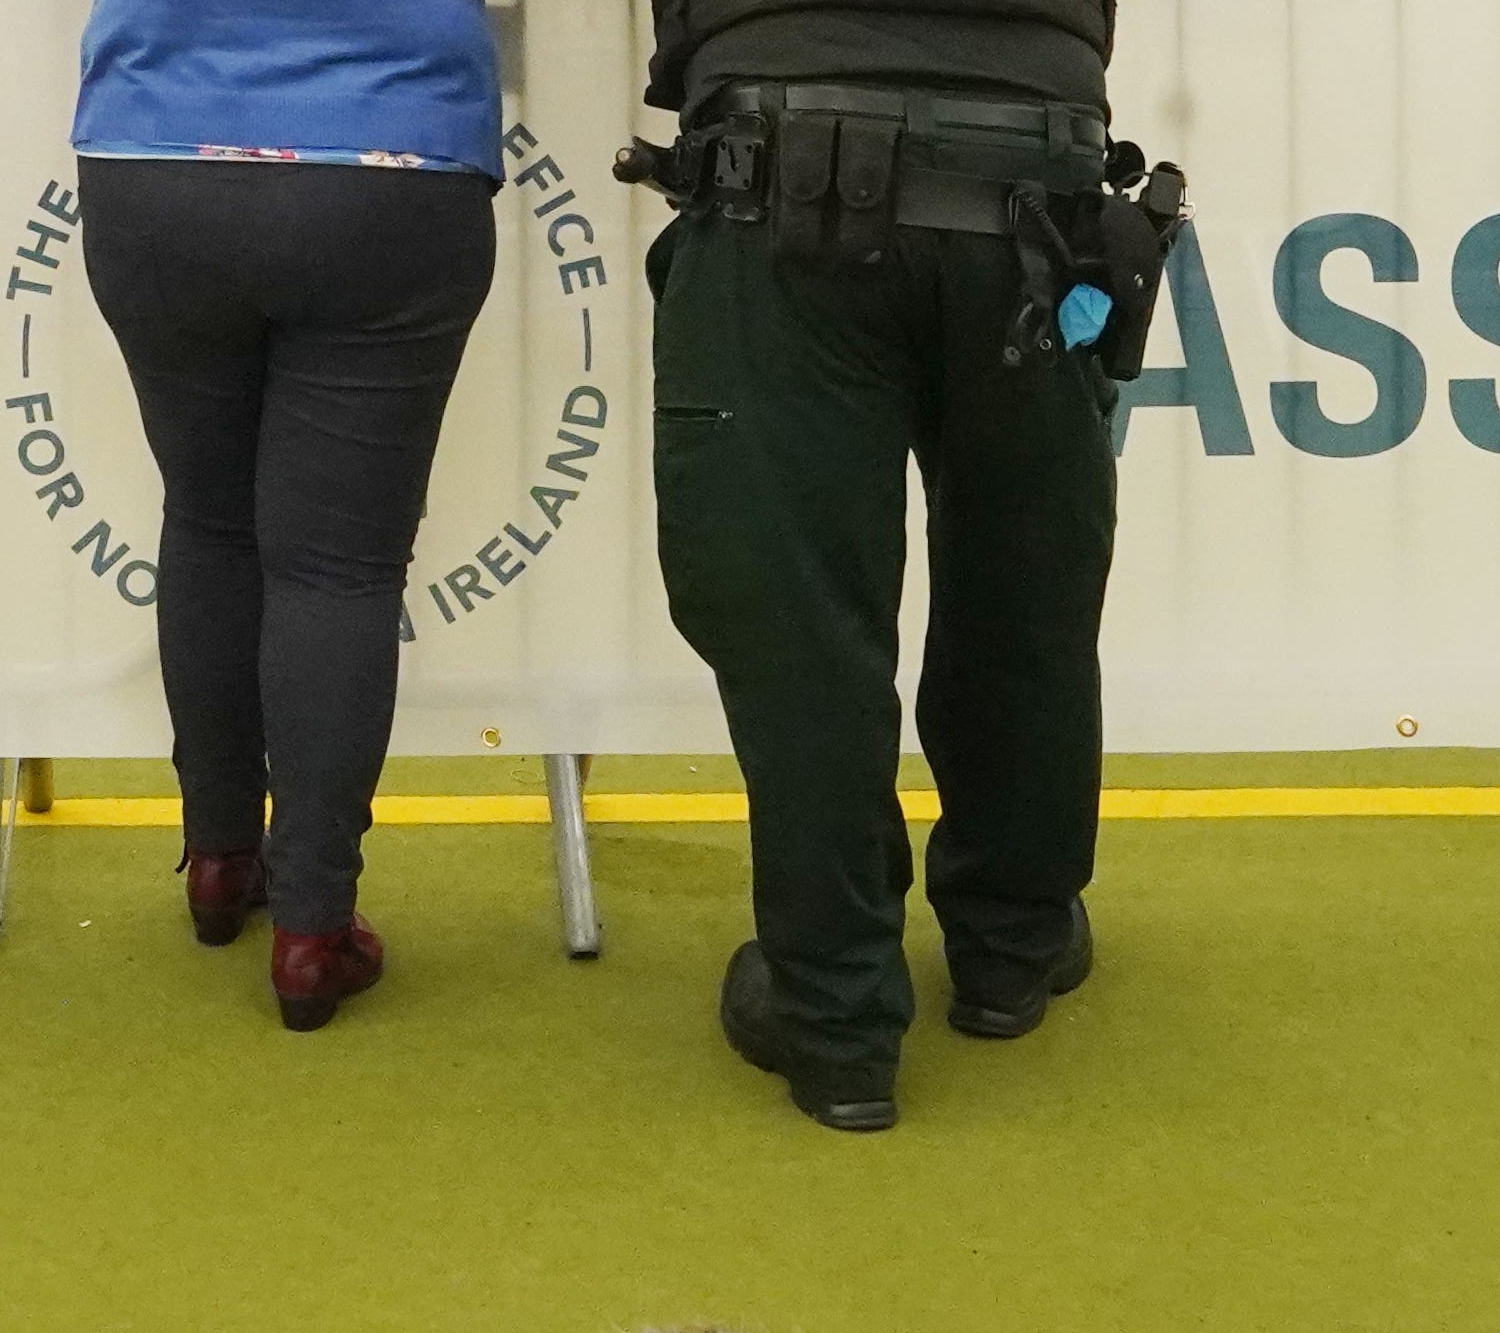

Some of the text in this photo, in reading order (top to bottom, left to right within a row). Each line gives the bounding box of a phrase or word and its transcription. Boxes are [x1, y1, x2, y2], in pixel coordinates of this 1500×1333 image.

[5, 180, 84, 303] THE
[503, 122, 608, 296] FFICE
[4, 394, 85, 521] FOR
[428, 384, 608, 625] IRELAND
